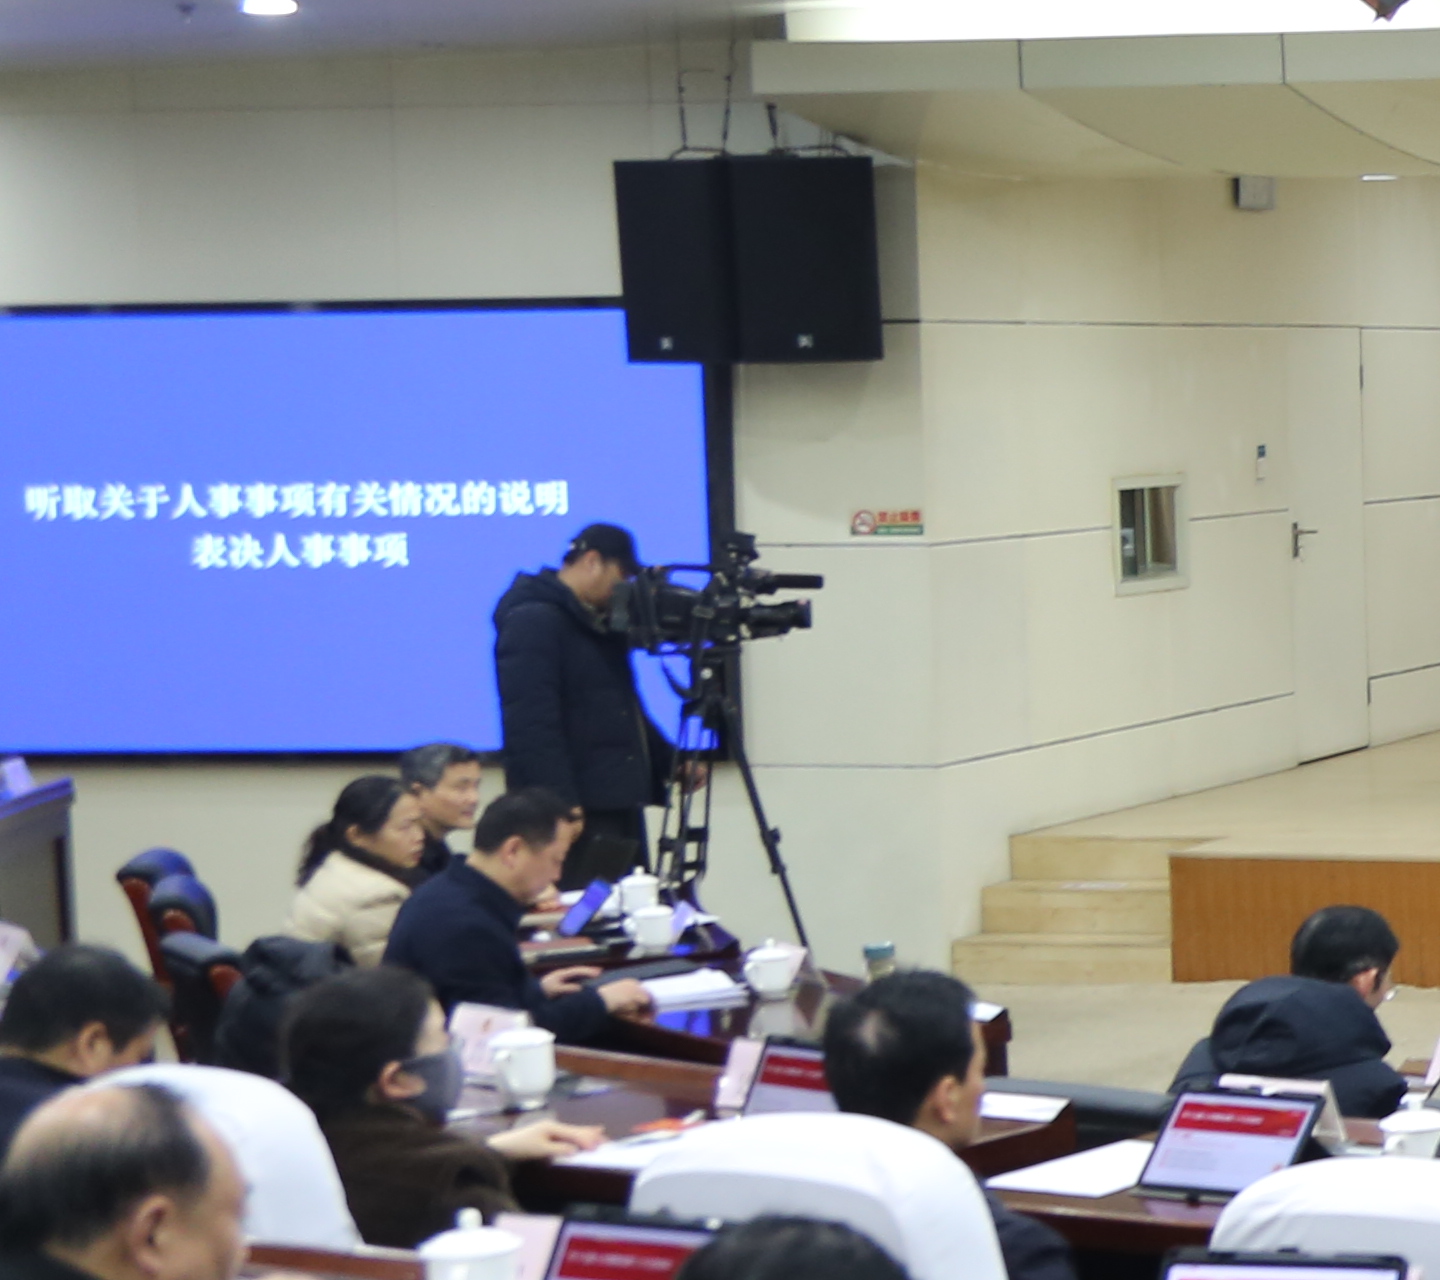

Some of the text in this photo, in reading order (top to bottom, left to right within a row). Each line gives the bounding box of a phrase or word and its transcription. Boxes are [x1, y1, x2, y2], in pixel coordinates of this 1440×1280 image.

[24, 480, 570, 520] 听取关于人事事项有关情况的说明
[191, 531, 410, 570] 表决人事事项
